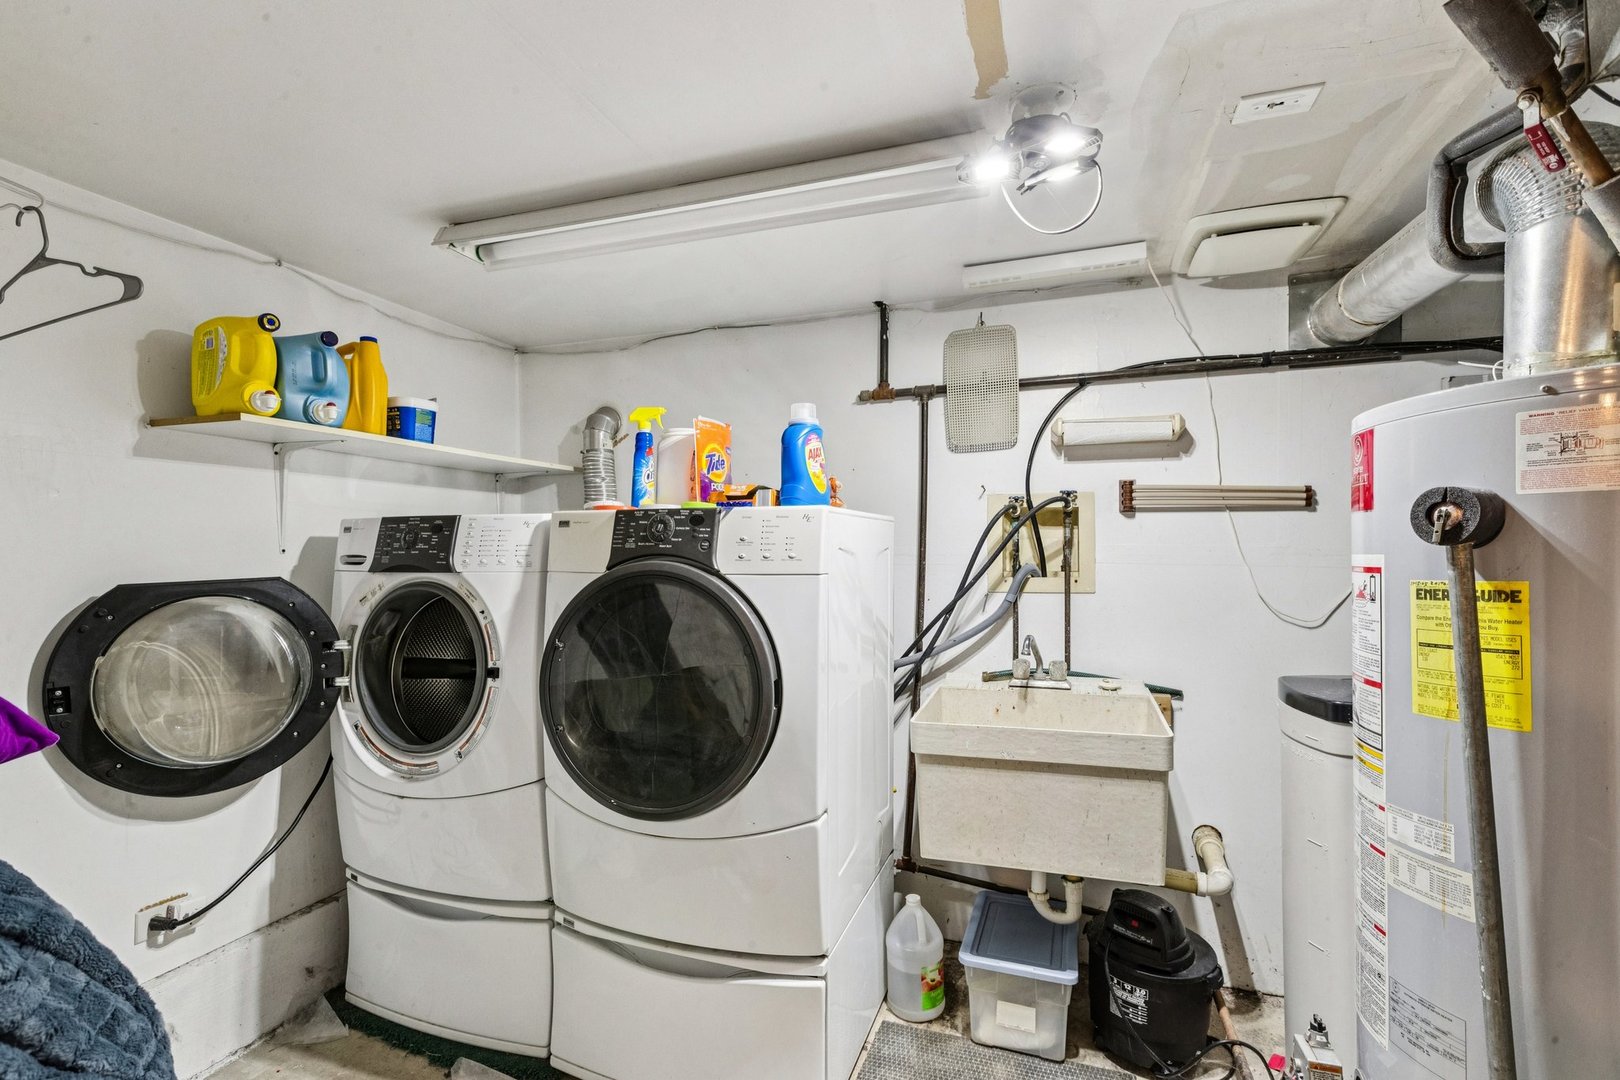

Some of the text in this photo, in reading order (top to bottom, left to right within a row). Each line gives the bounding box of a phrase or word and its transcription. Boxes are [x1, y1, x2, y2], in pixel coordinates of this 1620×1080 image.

[808, 447, 822, 461] AJAX
[706, 453, 726, 475] Tide
[1416, 588, 1450, 602] ENER
